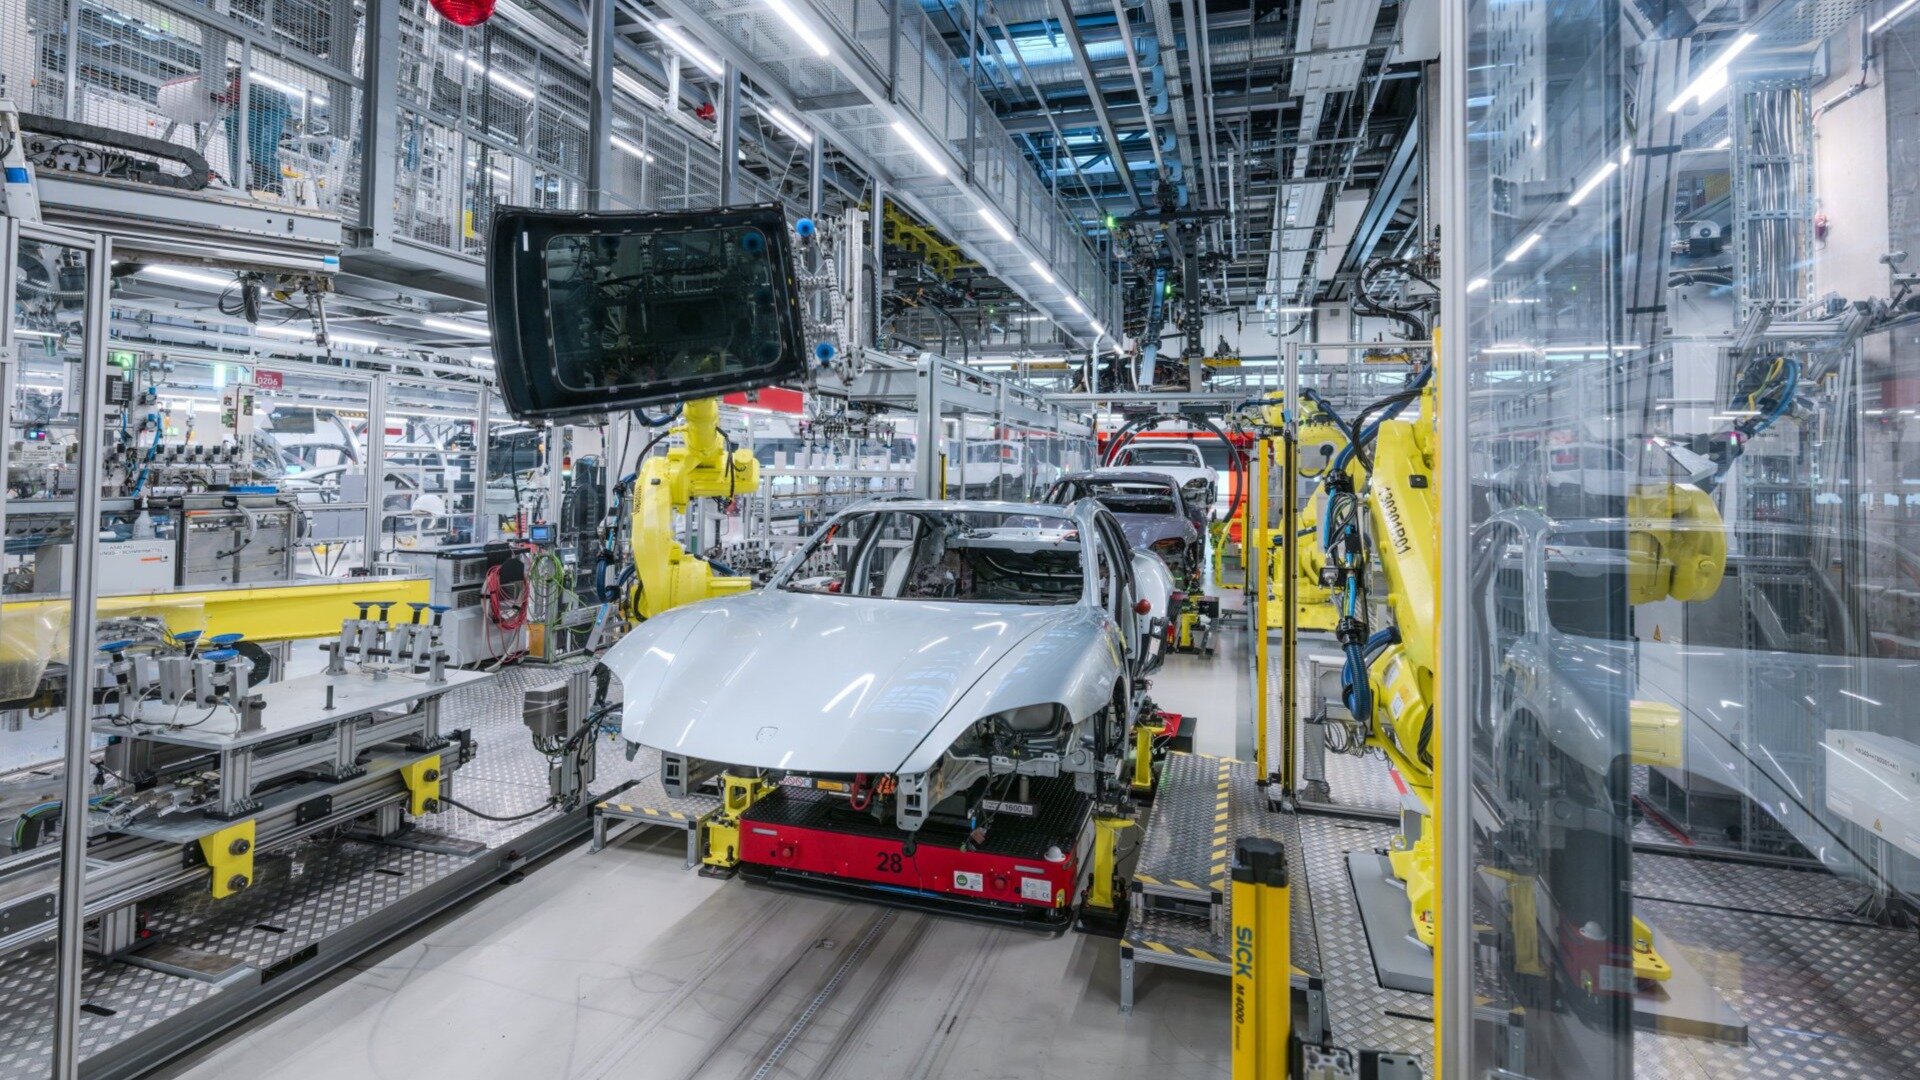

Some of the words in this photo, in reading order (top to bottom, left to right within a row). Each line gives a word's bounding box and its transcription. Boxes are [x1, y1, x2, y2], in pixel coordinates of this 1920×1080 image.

[1004, 804, 1022, 812] 1600
[876, 851, 903, 873] 28
[1236, 926, 1253, 979] SICK
[1236, 983, 1245, 995] M
[1236, 997, 1245, 1024] 4000
